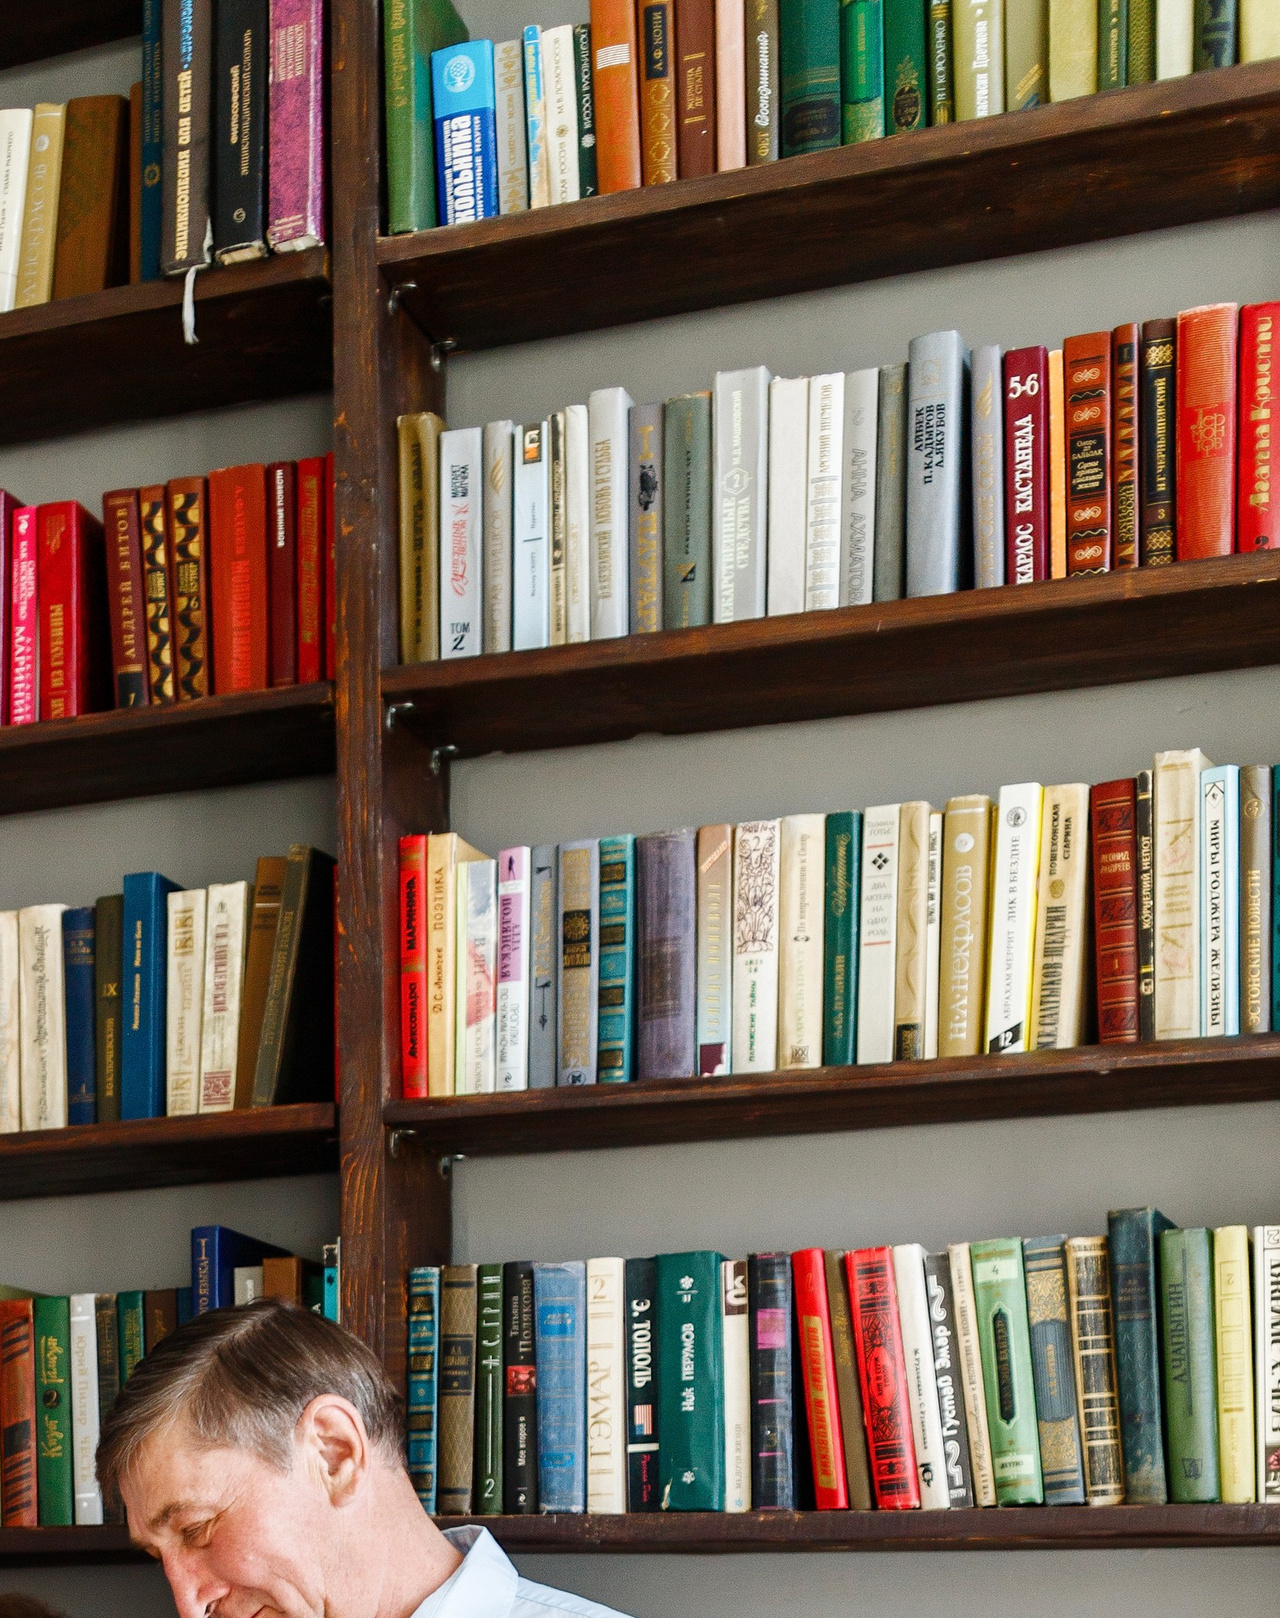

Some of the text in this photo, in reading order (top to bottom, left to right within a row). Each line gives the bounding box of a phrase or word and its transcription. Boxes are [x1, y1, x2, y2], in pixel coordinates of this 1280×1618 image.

[243, 29, 252, 72] СЛОВАРЬ
[230, 65, 240, 144] ФИЛОСОФСКИЙ
[175, 70, 192, 260] ЭНЦИКЛОПЕДИЯ ДЛЯ ДЕТЕЙ
[914, 407, 924, 452] АЙБЕК
[737, 496, 751, 569] СРЕДСТВА
[1015, 414, 1034, 582] КАРЛОС КАСТАНЕДА
[117, 507, 136, 658] АНДРЕЙ БИТОВ
[1009, 835, 1021, 882] БЕЗДНЕ
[1049, 804, 1059, 875] ПОШЕХОНСКАЯ
[1063, 817, 1072, 859] СТАРИНА
[1007, 898, 1017, 923] ЛИК
[1141, 836, 1151, 928] КОРНЕЛИЙ НЕПОТ
[1209, 820, 1220, 1025] МИРЫ РОДЖЕРА ЖЕЛЯЗНЫ
[1249, 870, 1261, 1025] ЭСТОНСКИЕ ПОВЕСТИ
[509, 1296, 519, 1336] Татьяна
[520, 1277, 532, 1352] Полякова
[935, 1325, 951, 1369] Эмар
[633, 1321, 651, 1387] ТОПОЛЬ
[681, 1323, 694, 1411] Ник ПЕРУМОВ
